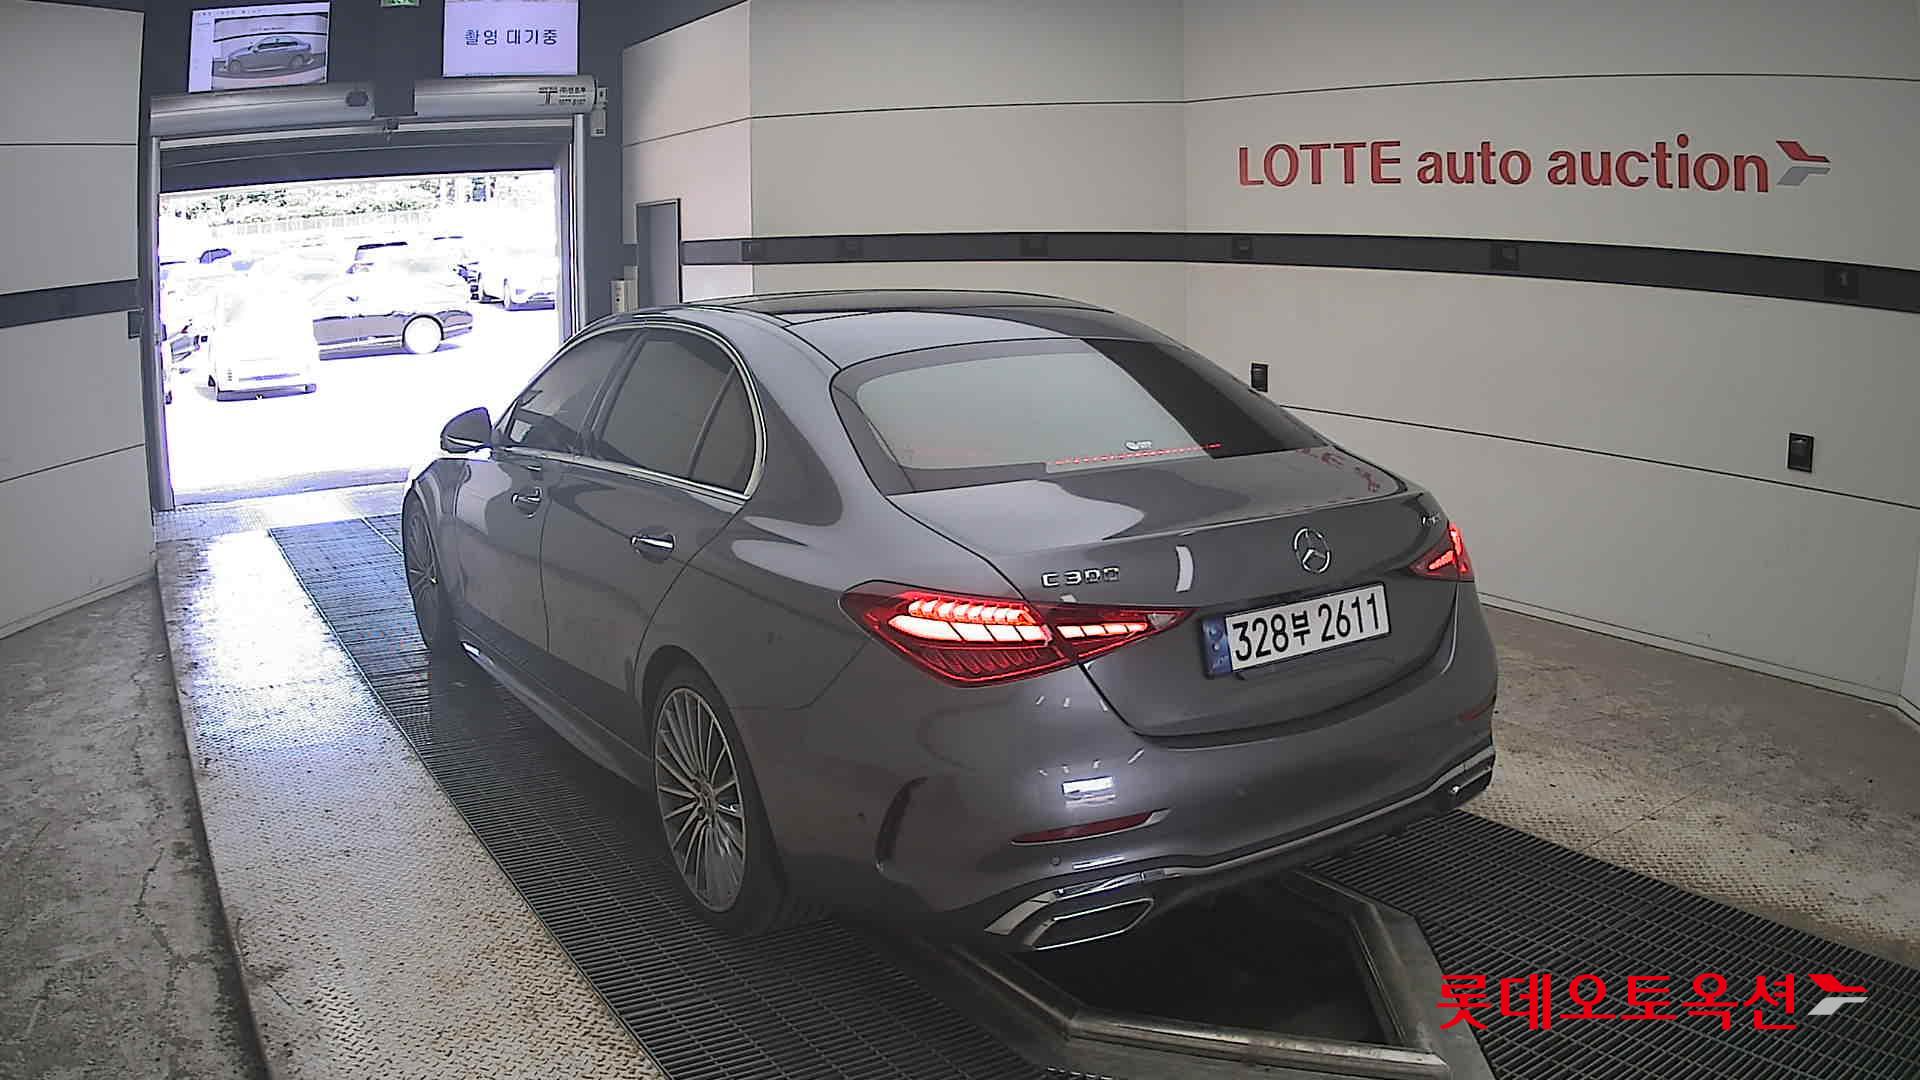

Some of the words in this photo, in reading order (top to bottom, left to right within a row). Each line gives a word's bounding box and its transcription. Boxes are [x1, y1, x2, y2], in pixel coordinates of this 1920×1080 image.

[465, 28, 498, 46] 촬영
[505, 27, 558, 46] 대기중
[1238, 140, 1401, 187] LOTTE
[1416, 141, 1532, 185] auto
[1547, 134, 1769, 192] auction
[1041, 573, 1060, 588] C
[1064, 566, 1120, 585] 300
[1231, 610, 1311, 662] 328부
[1318, 592, 1379, 642] 2611
